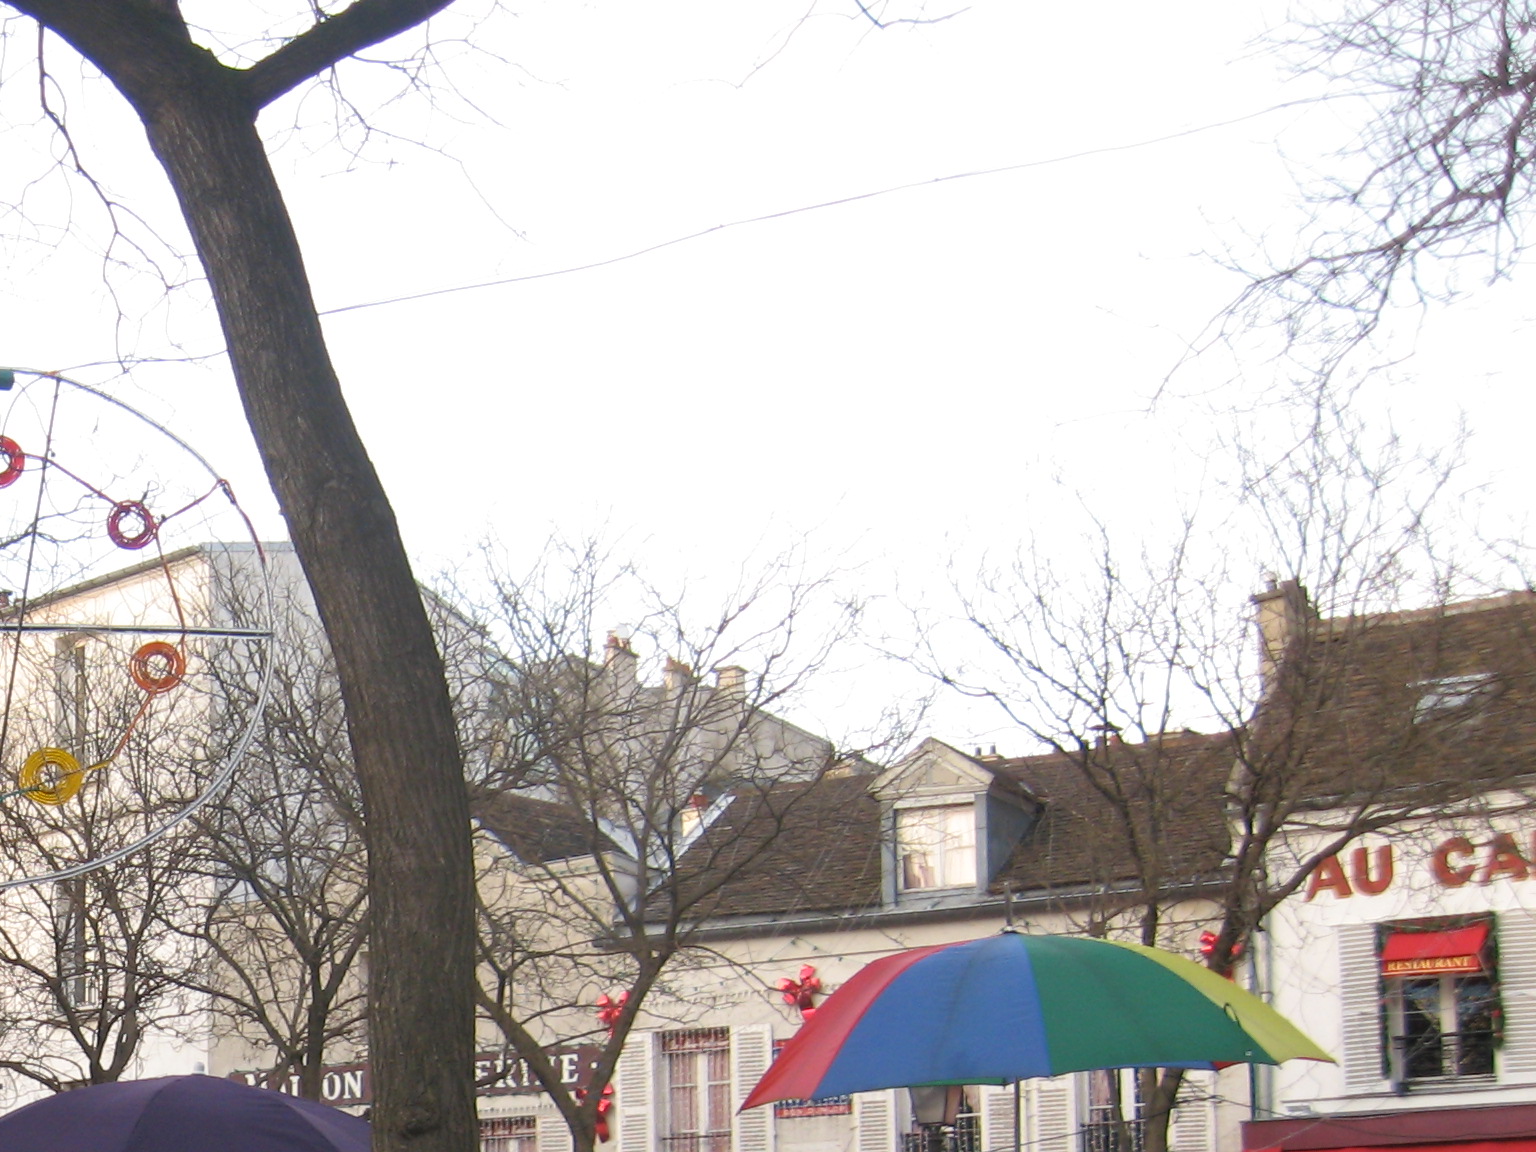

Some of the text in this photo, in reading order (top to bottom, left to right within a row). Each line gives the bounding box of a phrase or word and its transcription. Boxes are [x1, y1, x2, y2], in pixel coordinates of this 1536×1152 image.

[1304, 830, 1536, 902] AU CA
[1387, 957, 1470, 971] RESTAURANT
